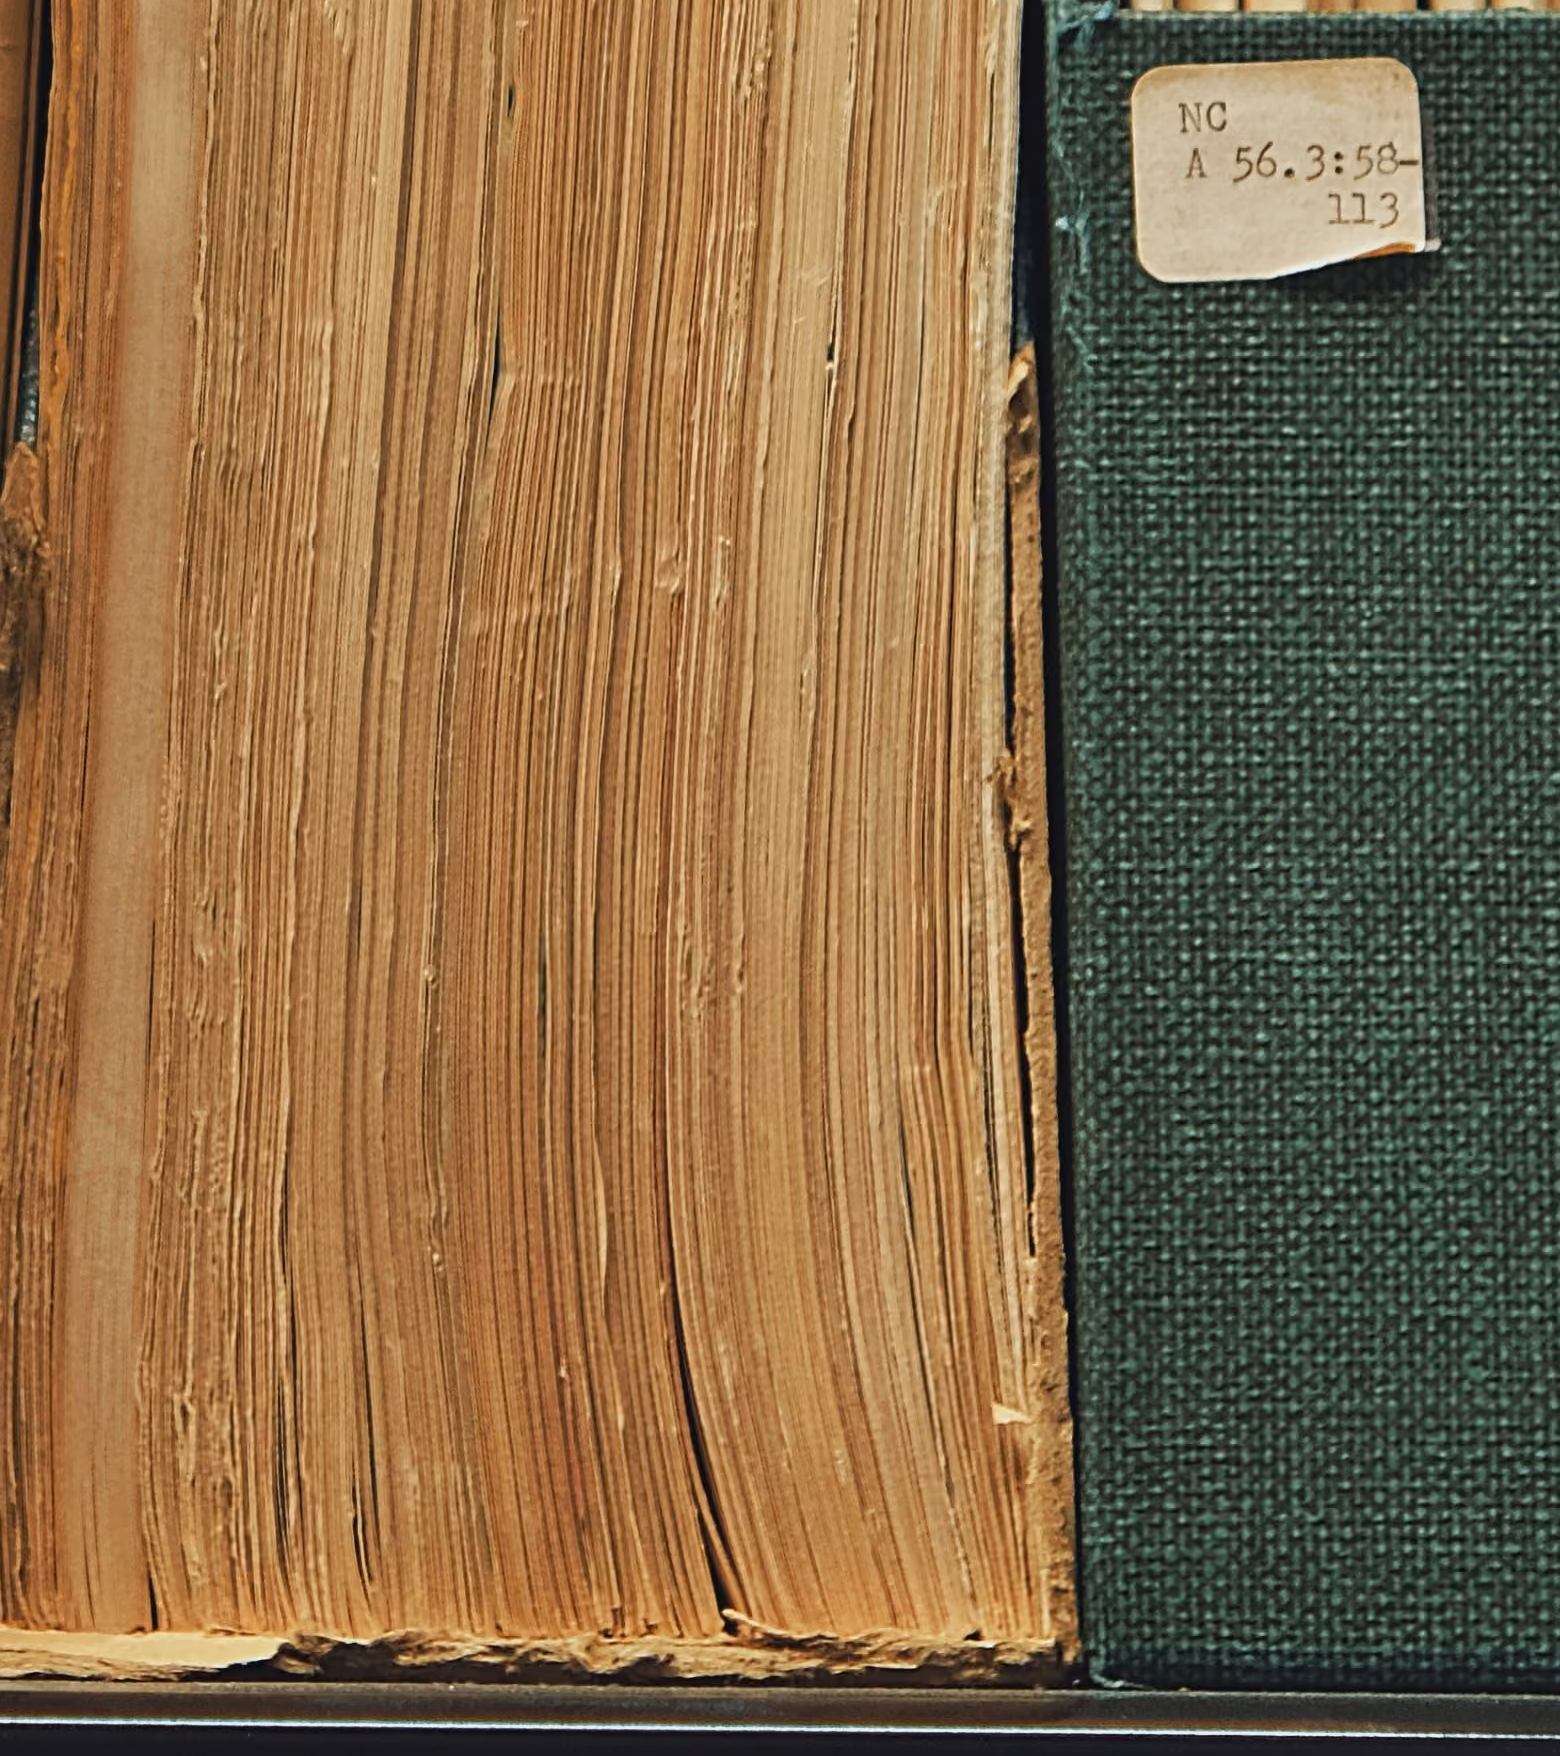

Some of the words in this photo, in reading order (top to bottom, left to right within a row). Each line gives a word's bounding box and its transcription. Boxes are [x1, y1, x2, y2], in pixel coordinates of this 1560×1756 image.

[1179, 101, 1227, 133] NC
[1185, 148, 1207, 180] A
[1232, 141, 1420, 184] 56.3:58-
[1328, 192, 1400, 229] 113
